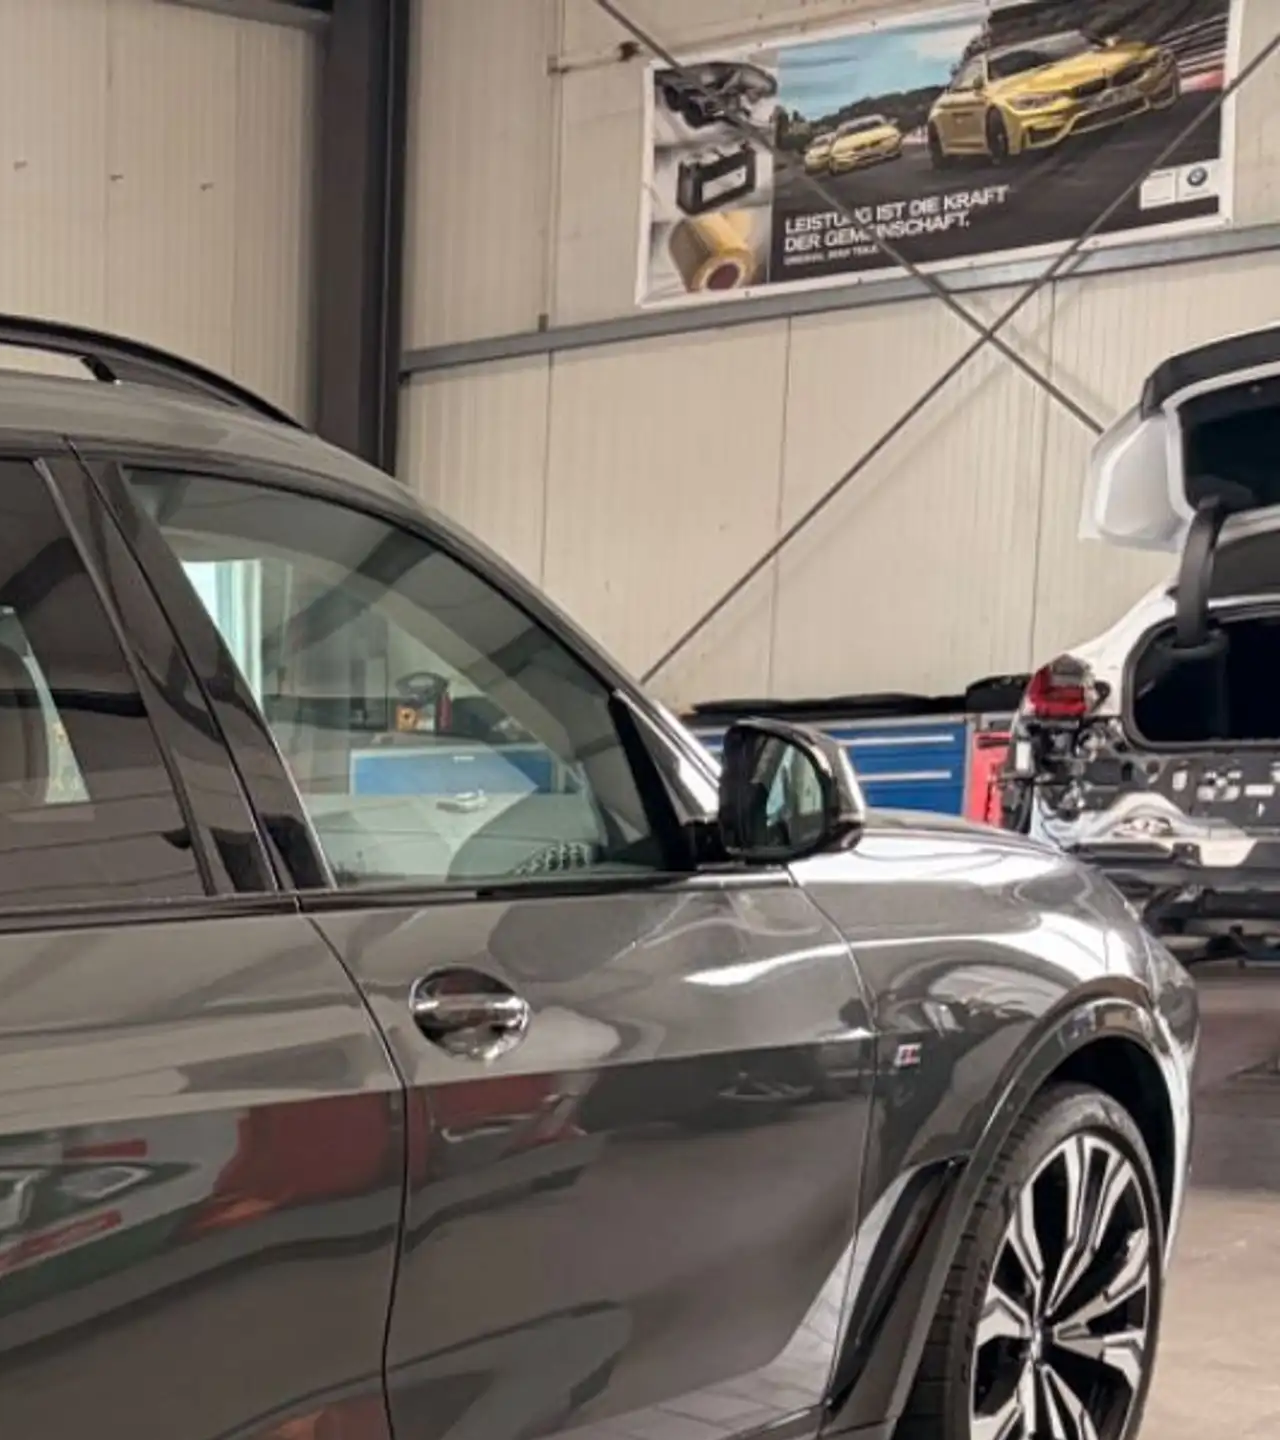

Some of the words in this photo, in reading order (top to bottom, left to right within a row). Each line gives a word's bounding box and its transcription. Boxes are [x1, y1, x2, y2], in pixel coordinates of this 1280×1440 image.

[876, 201, 907, 222] IST
[908, 196, 940, 217] DIE
[943, 184, 1009, 211] KRAFT
[784, 232, 821, 253] DER
[823, 210, 971, 247] GEMINSCHAFT.
